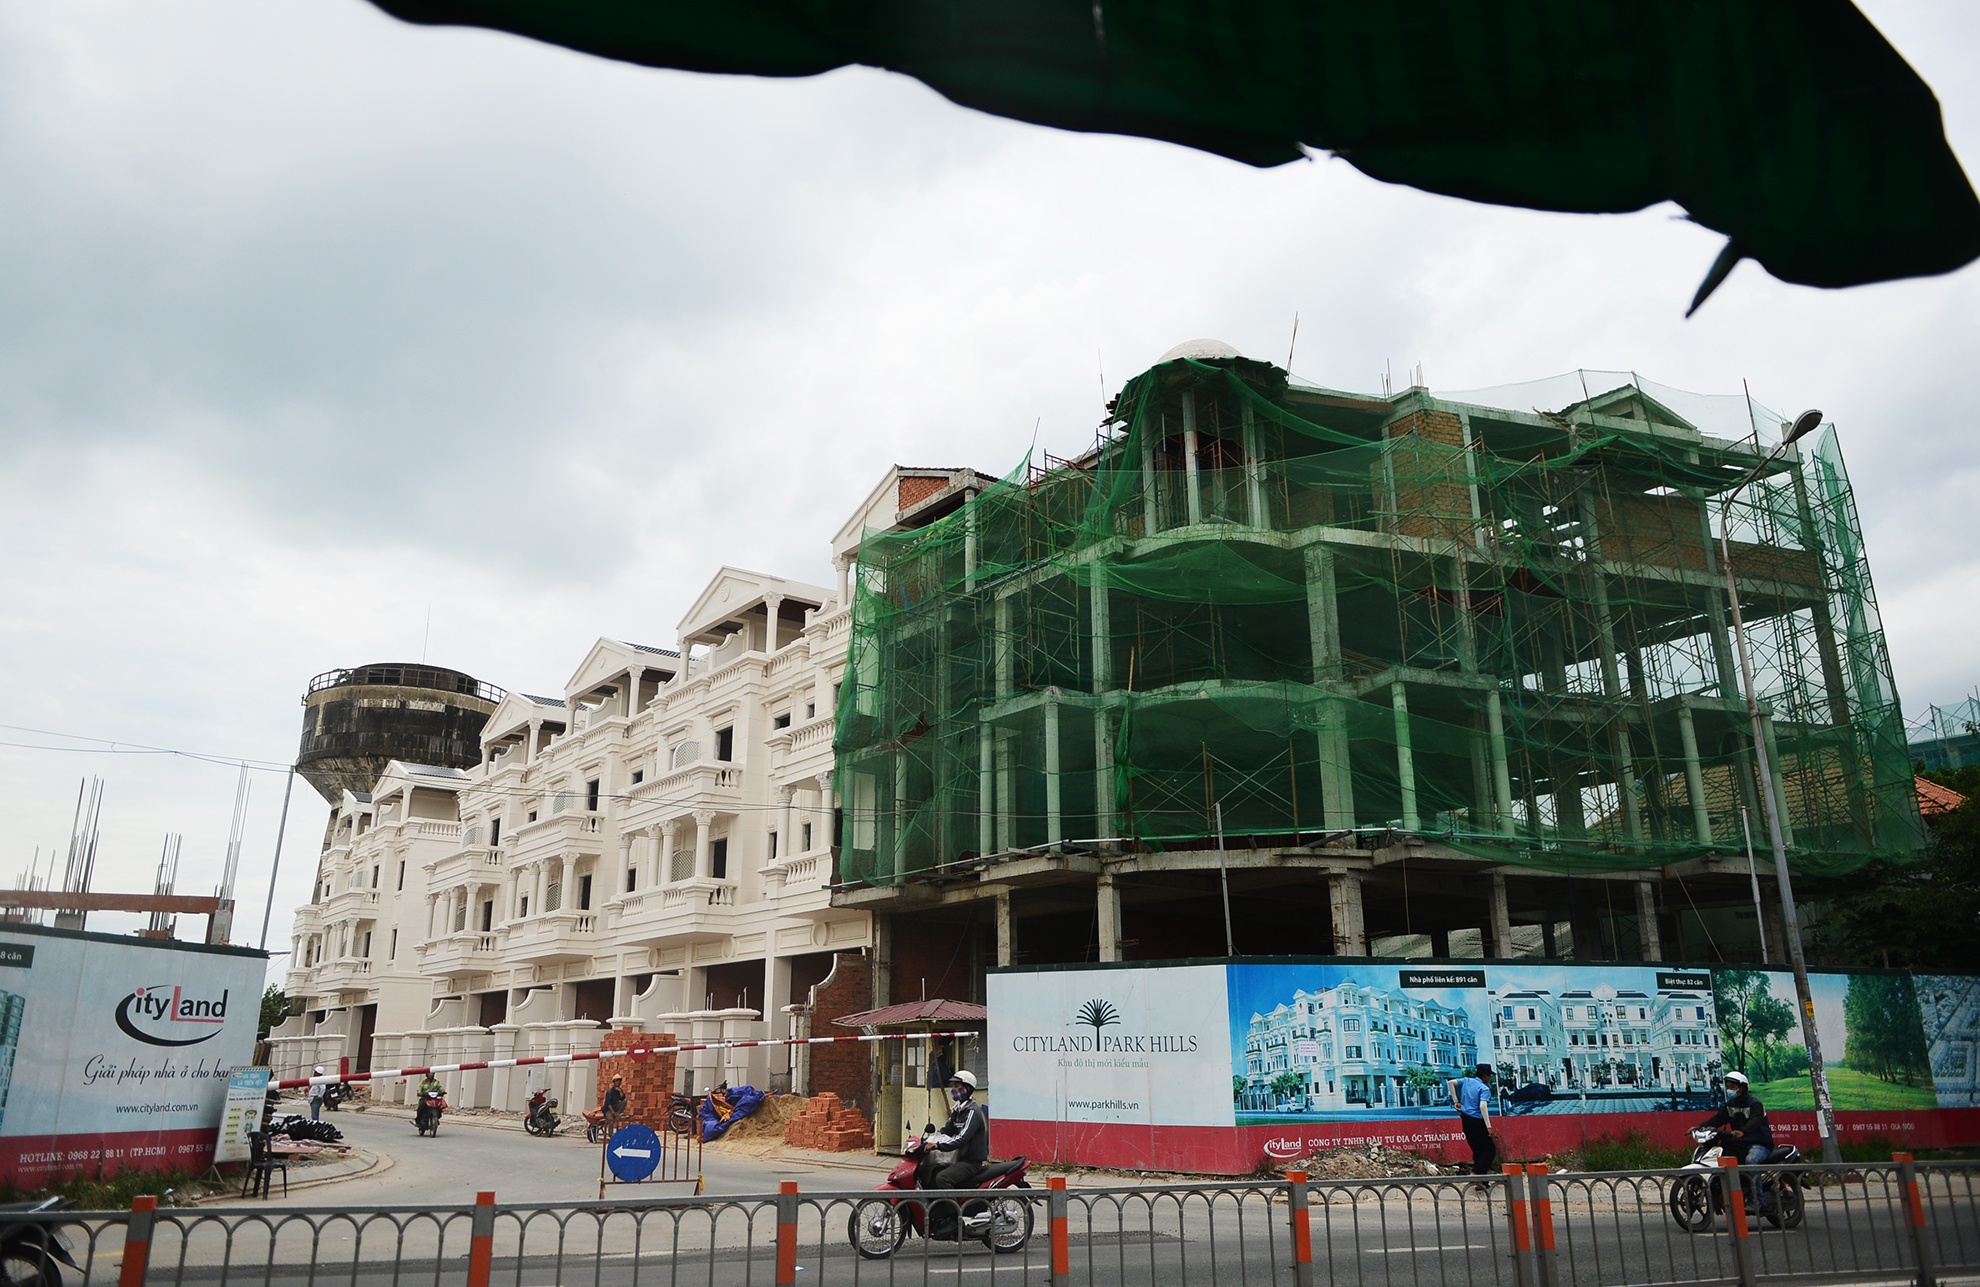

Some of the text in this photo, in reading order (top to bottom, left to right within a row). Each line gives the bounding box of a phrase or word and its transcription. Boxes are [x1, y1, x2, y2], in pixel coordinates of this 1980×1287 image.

[1013, 1035, 1198, 1052] CITYLAND PARK HILLS
[1058, 1058, 1072, 1067] Khu
[83, 1054, 117, 1085] Giải
[117, 1057, 150, 1085] pháp
[154, 1058, 175, 1078] nhà
[180, 1065, 188, 1078] ở
[191, 1058, 210, 1078] cho
[116, 1103, 198, 1115] www.cityland.com.vn
[1068, 1100, 1139, 1110] www.parkhills.vn
[1308, 1138, 1330, 1147] CÔNG
[1344, 1137, 1364, 1145] TNHH
[20, 1152, 66, 1163] HOTLINE:
[68, 1150, 88, 1160] 0968
[90, 1150, 100, 1159] 22
[105, 1149, 114, 1158] 88
[116, 1149, 124, 1158] 11
[130, 1146, 166, 1158] (TP.HCM)
[178, 1144, 194, 1154] 0967
